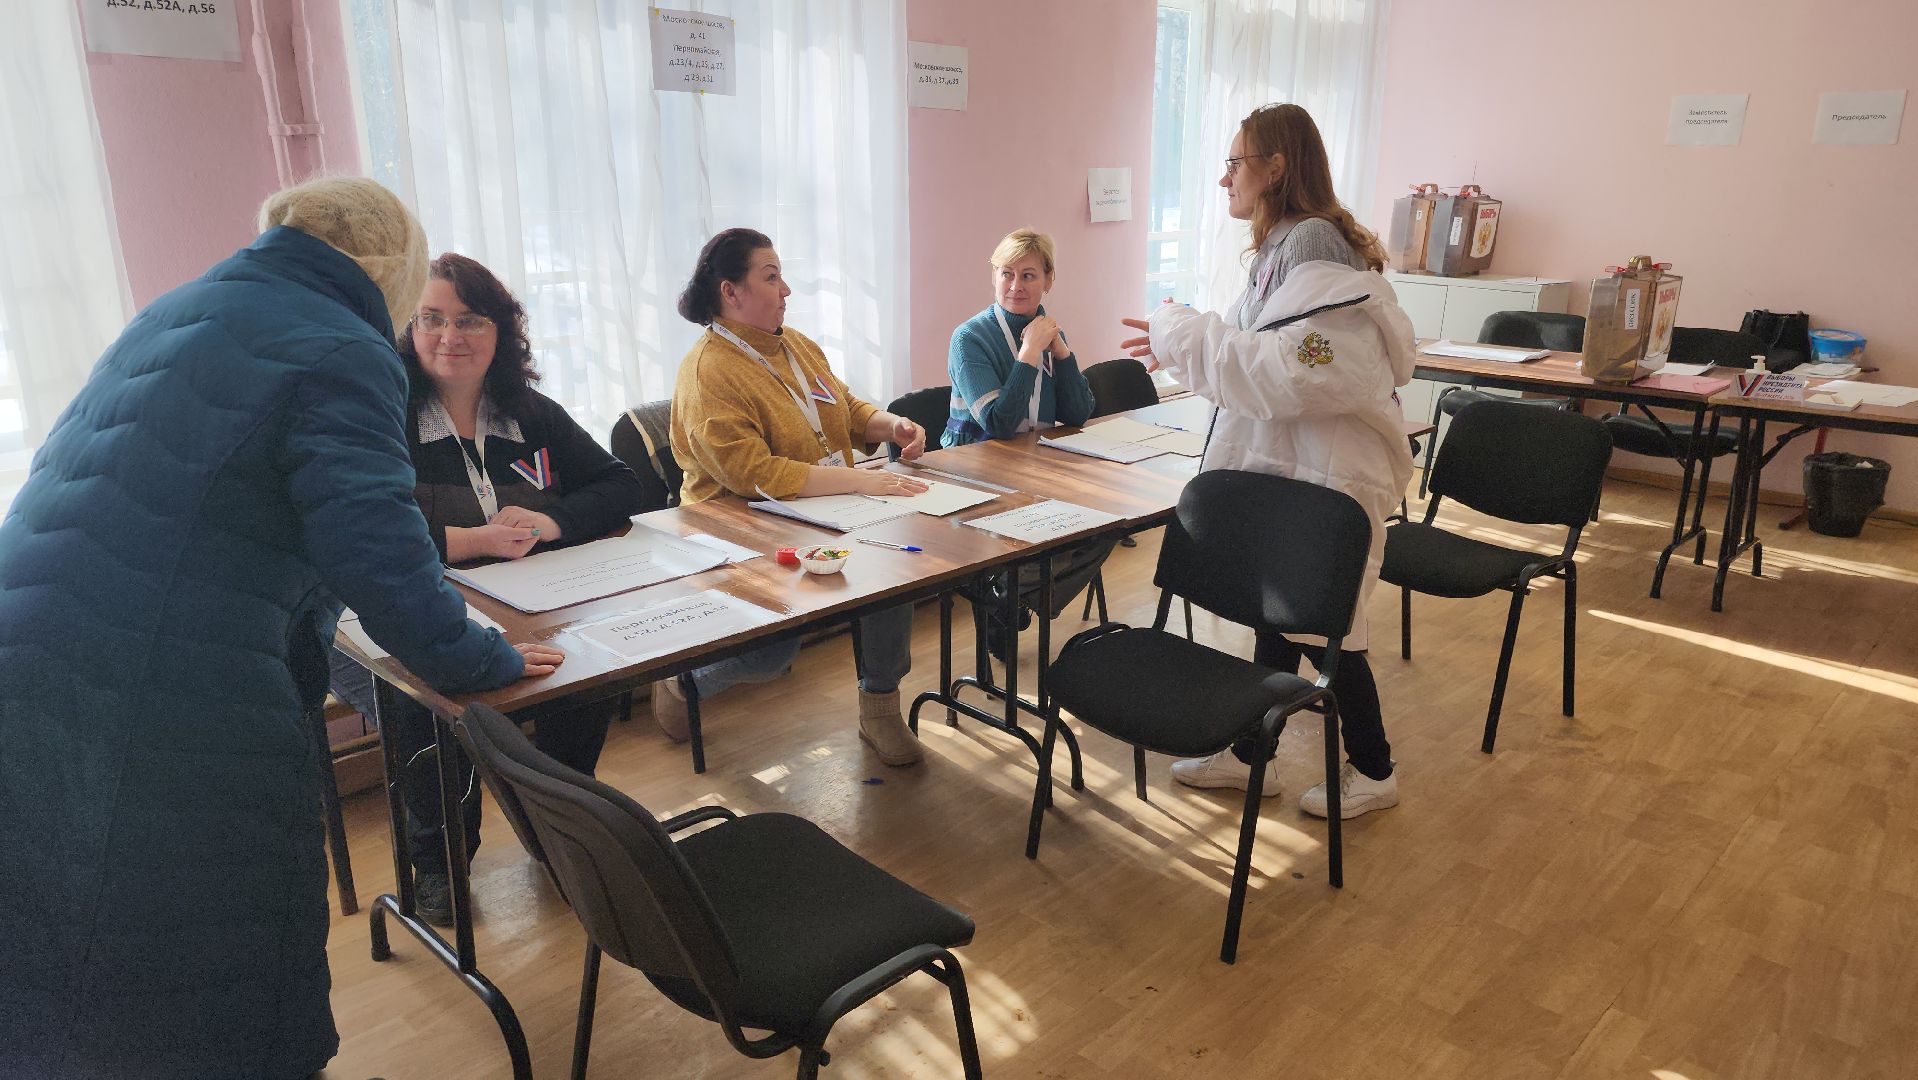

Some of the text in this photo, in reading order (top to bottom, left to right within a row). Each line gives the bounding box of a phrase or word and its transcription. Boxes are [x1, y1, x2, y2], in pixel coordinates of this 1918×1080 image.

[143, 0, 185, 13] д.52А,
[188, 3, 216, 15] д.56
[1831, 114, 1888, 122] Председатель
